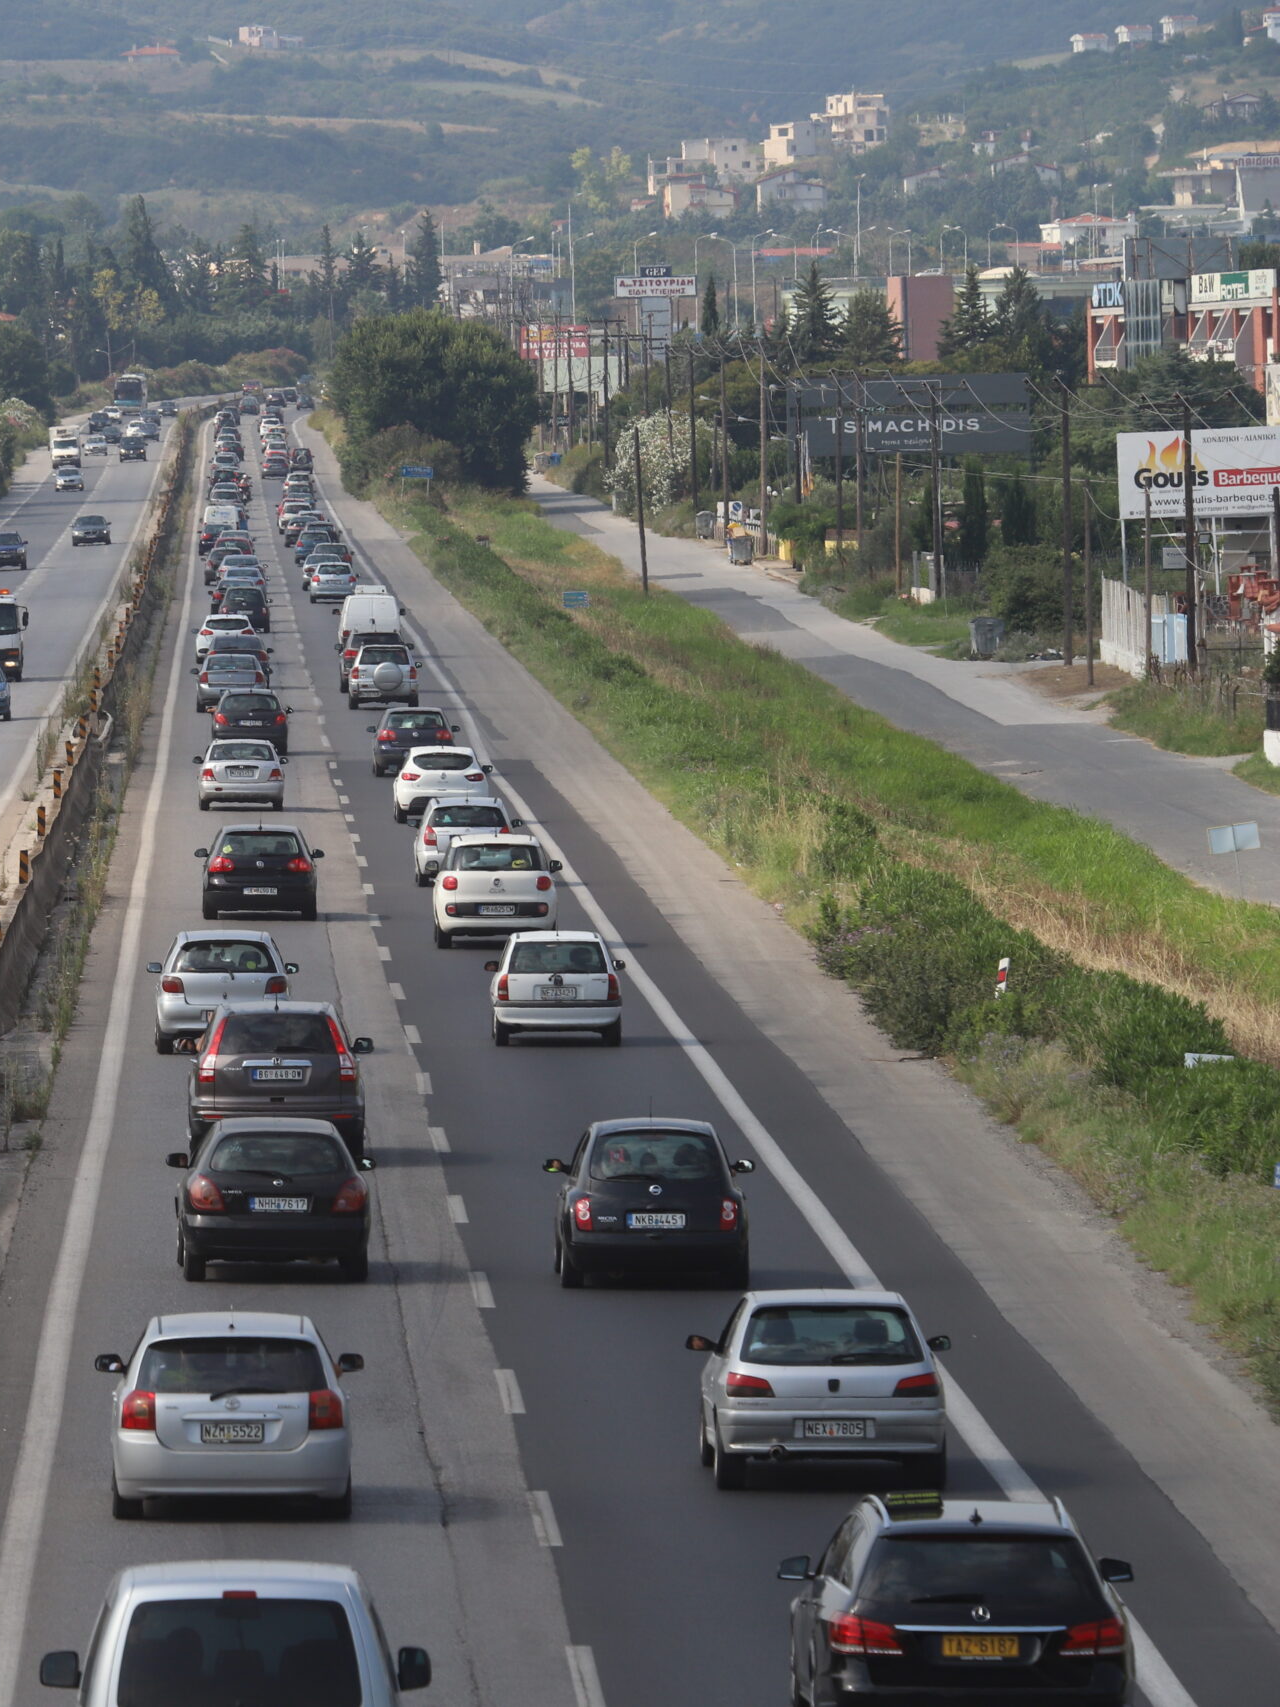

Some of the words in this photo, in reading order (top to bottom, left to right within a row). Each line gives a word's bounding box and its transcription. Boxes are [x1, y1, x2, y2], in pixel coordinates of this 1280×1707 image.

[1198, 274, 1215, 294] B&W
[1098, 281, 1124, 307] TDK
[1134, 465, 1209, 489] Gouis
[259, 1070, 269, 1079] BG
[258, 1199, 277, 1209] NHH
[281, 1199, 306, 1209] 7617
[635, 1215, 654, 1225] NKB
[658, 1215, 684, 1225] 4451
[204, 1424, 225, 1438] NZM
[232, 1424, 261, 1438] 5522
[807, 1423, 827, 1435] NEX
[835, 1423, 863, 1435] 7805
[980, 1637, 1017, 1654] 6187
